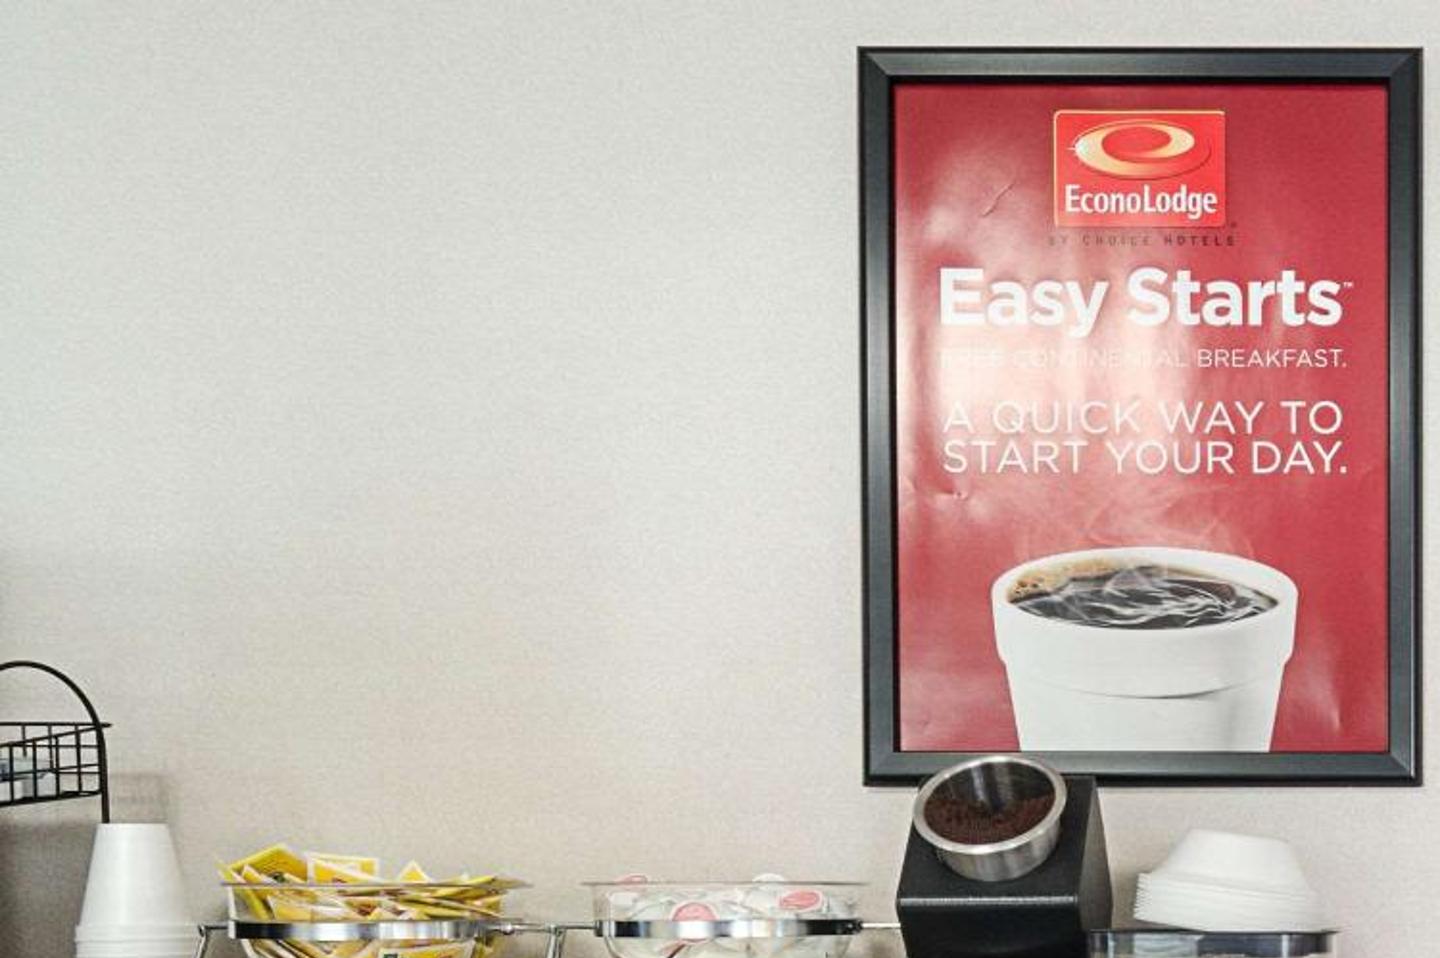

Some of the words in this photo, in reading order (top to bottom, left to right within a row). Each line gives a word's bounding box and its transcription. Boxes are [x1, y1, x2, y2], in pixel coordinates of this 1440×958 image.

[1065, 183, 1218, 220] EconoLodge
[1048, 235, 1068, 247] BY
[1082, 235, 1152, 247] CHOICE
[1163, 235, 1236, 247] HOTELS
[939, 267, 1109, 338] Easy
[1198, 348, 1348, 369] BREAKFAST.
[942, 401, 974, 435] A
[991, 401, 1142, 436] QUICK
[1158, 401, 1264, 435] WAY
[1280, 401, 1344, 435] TO
[942, 440, 1089, 475] START
[1105, 440, 1235, 475] YOUR
[1251, 440, 1348, 475] DAY.
